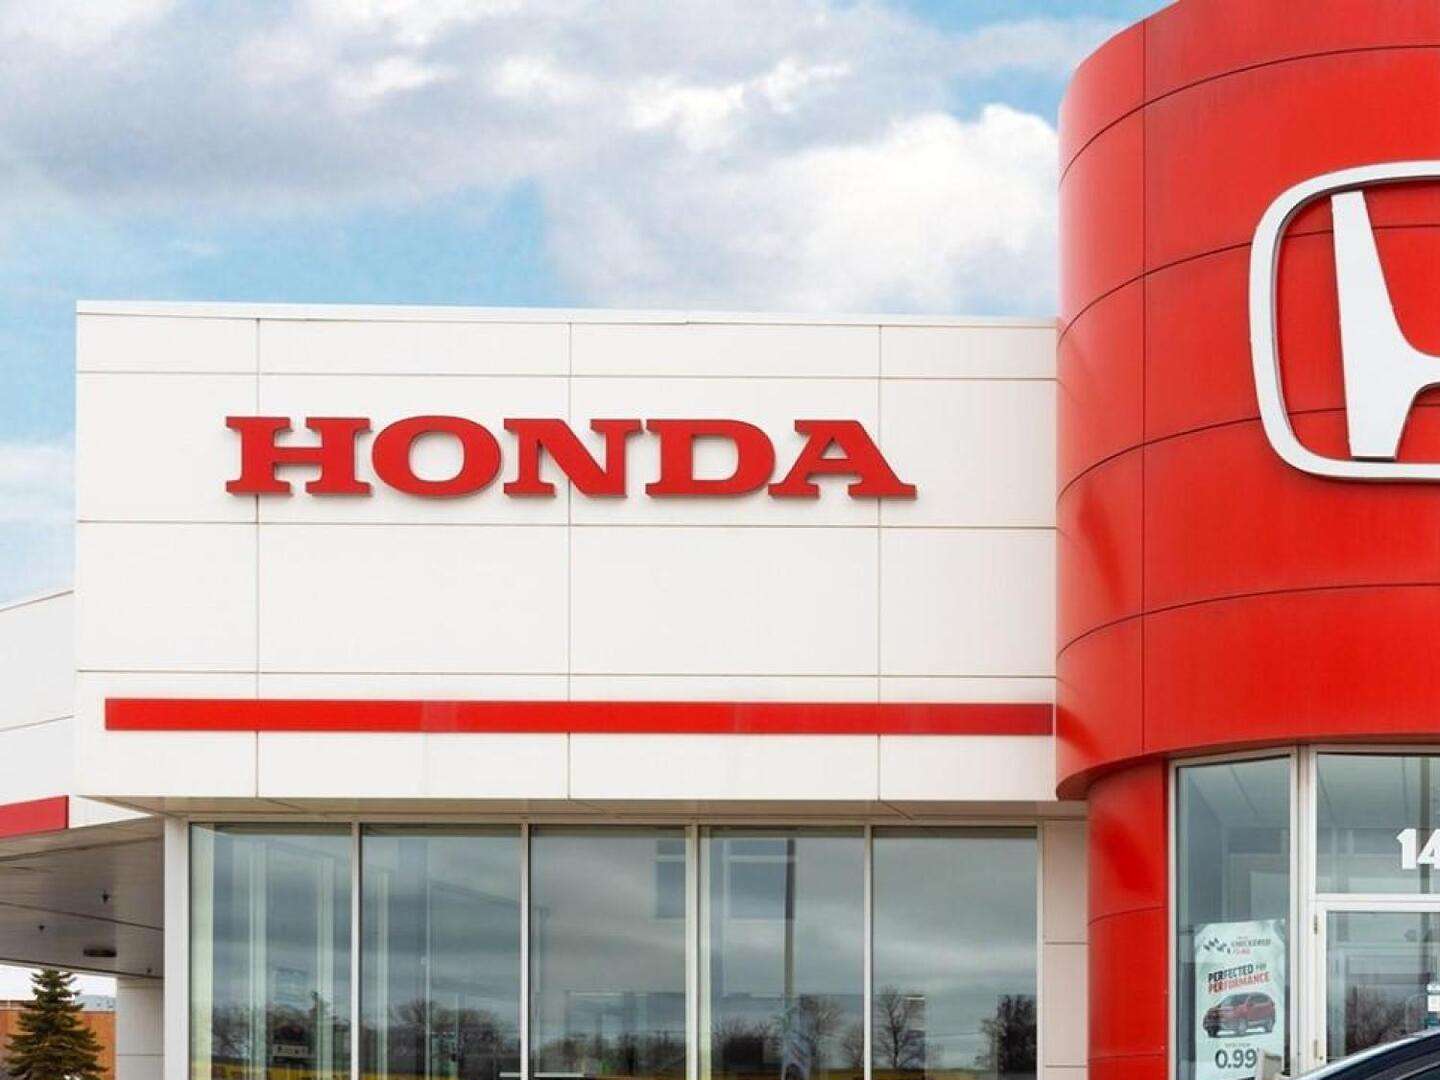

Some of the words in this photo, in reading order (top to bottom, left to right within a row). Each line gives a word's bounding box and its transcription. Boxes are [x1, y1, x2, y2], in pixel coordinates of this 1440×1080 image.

[226, 415, 917, 499] HONDA
[1208, 971, 1271, 994] PERFORMANCE
[1209, 964, 1253, 981] PERFECTED
